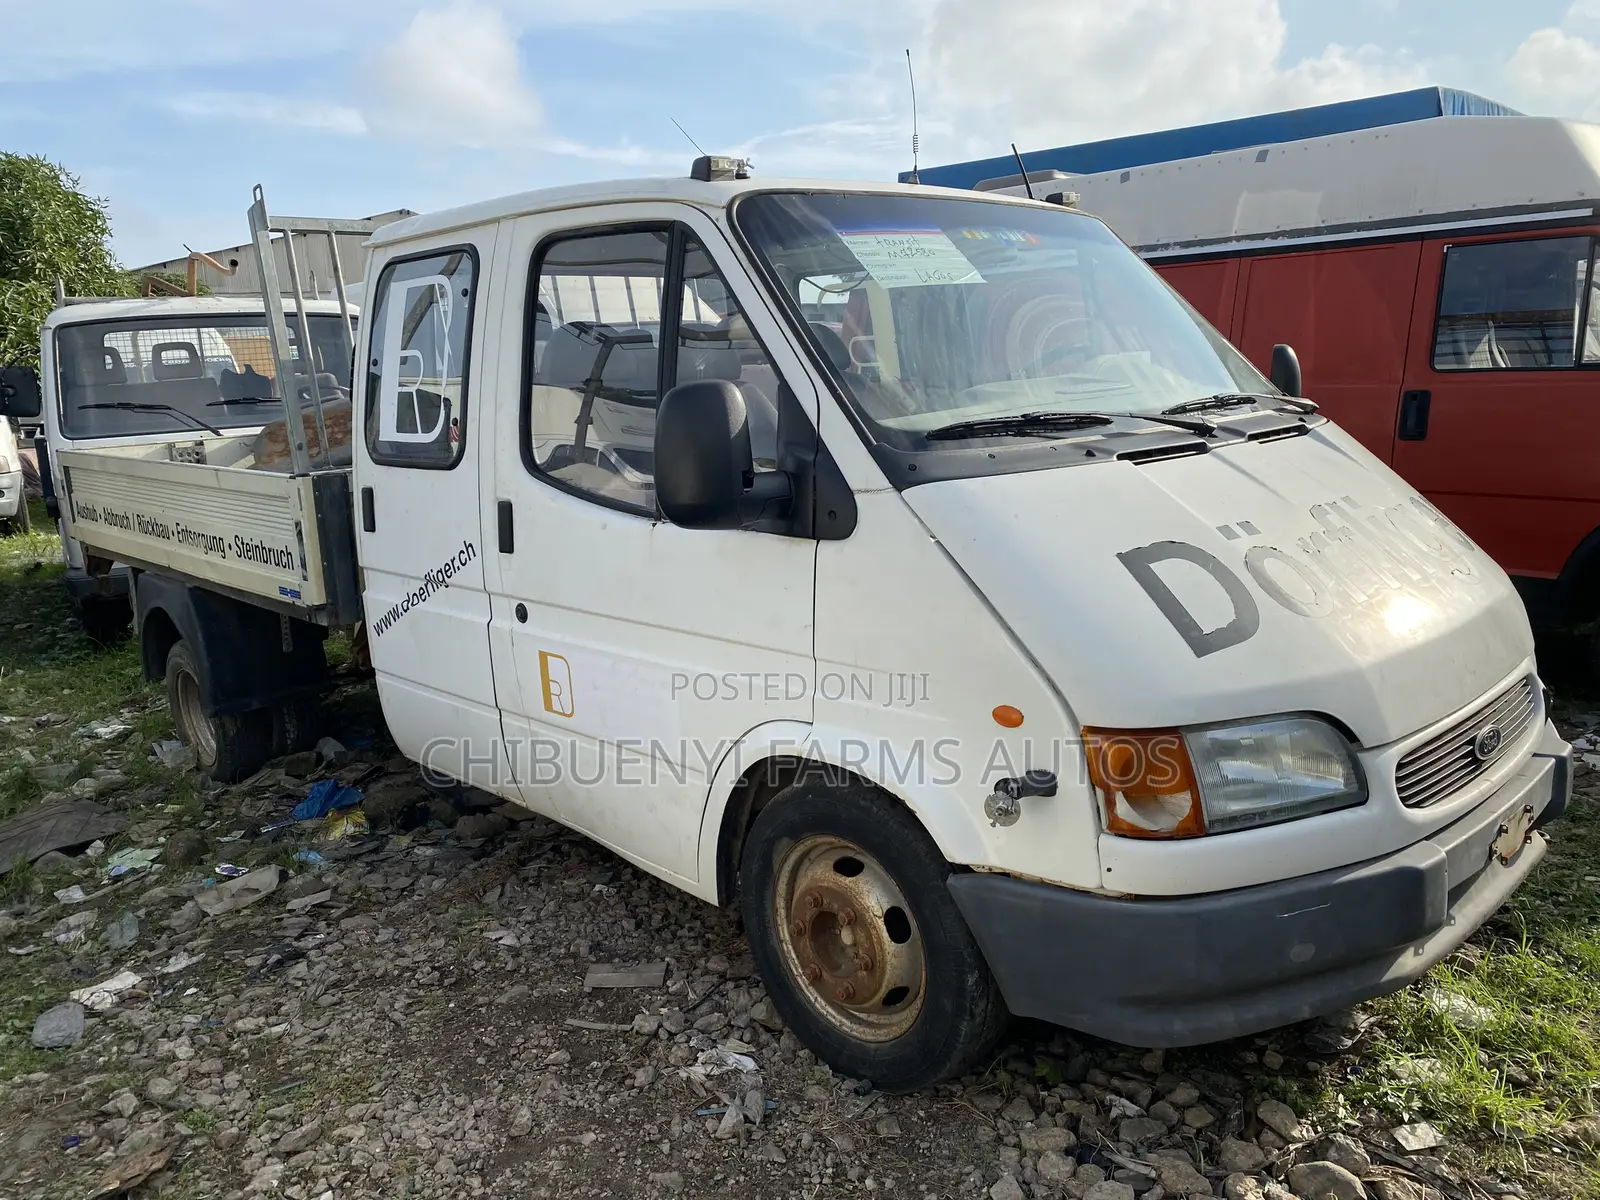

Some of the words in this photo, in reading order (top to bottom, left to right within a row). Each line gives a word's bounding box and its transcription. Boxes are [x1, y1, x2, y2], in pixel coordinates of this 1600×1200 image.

[76, 500, 98, 523] Aushub
[103, 507, 131, 530] Abbruch
[137, 513, 170, 541] Rückbau
[176, 522, 226, 559] Entsorgung
[234, 534, 295, 570] Steinbruch
[373, 540, 477, 637] www.doerfliger.ch
